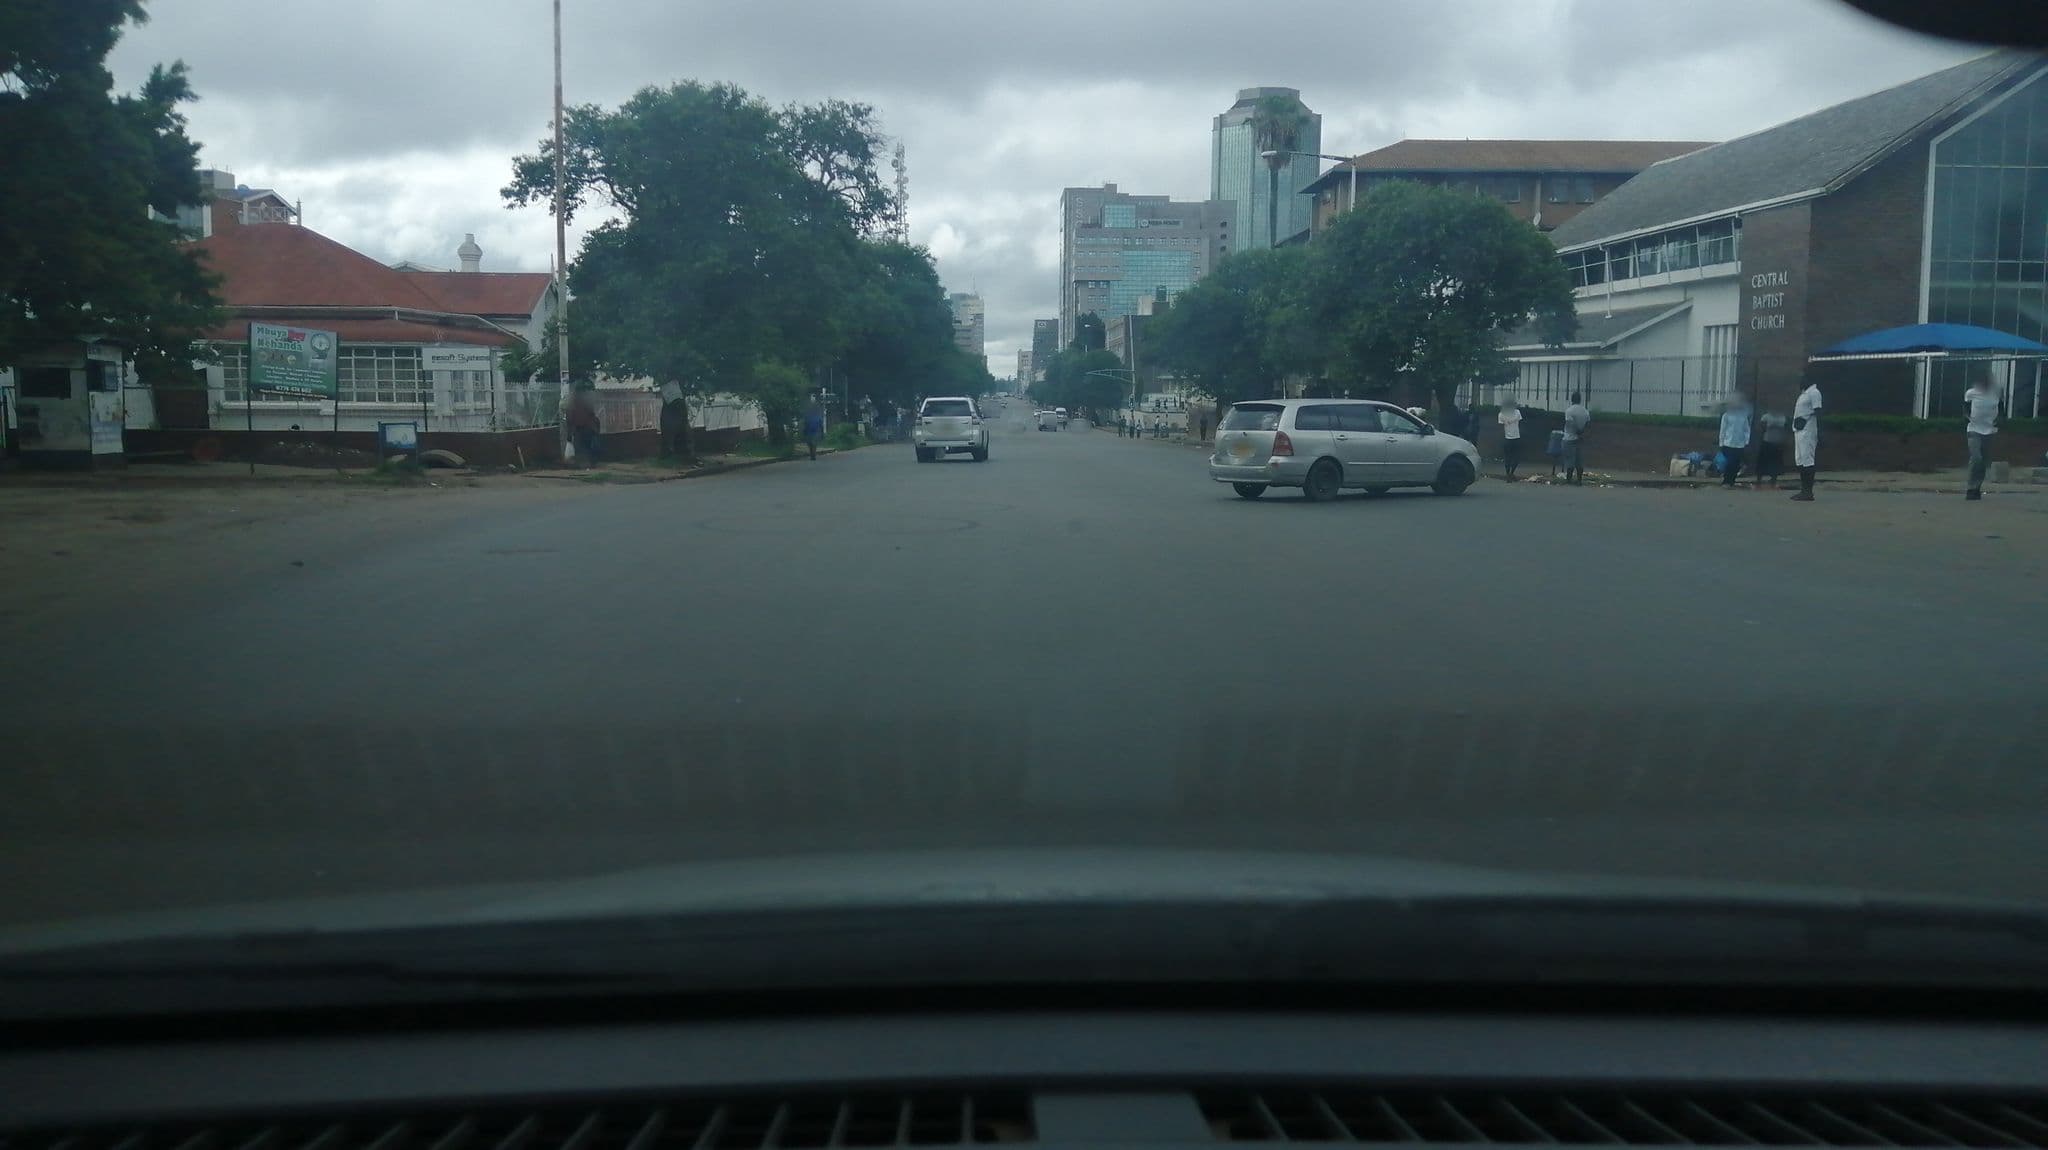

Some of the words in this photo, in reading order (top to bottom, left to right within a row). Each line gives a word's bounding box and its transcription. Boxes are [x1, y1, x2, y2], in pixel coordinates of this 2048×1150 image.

[1751, 270, 1788, 288] CENTRAL
[1752, 292, 1784, 309] BAPTIST
[1751, 314, 1785, 330] CHURCH
[256, 326, 288, 338] Mbuya
[257, 337, 303, 351] Nehanda
